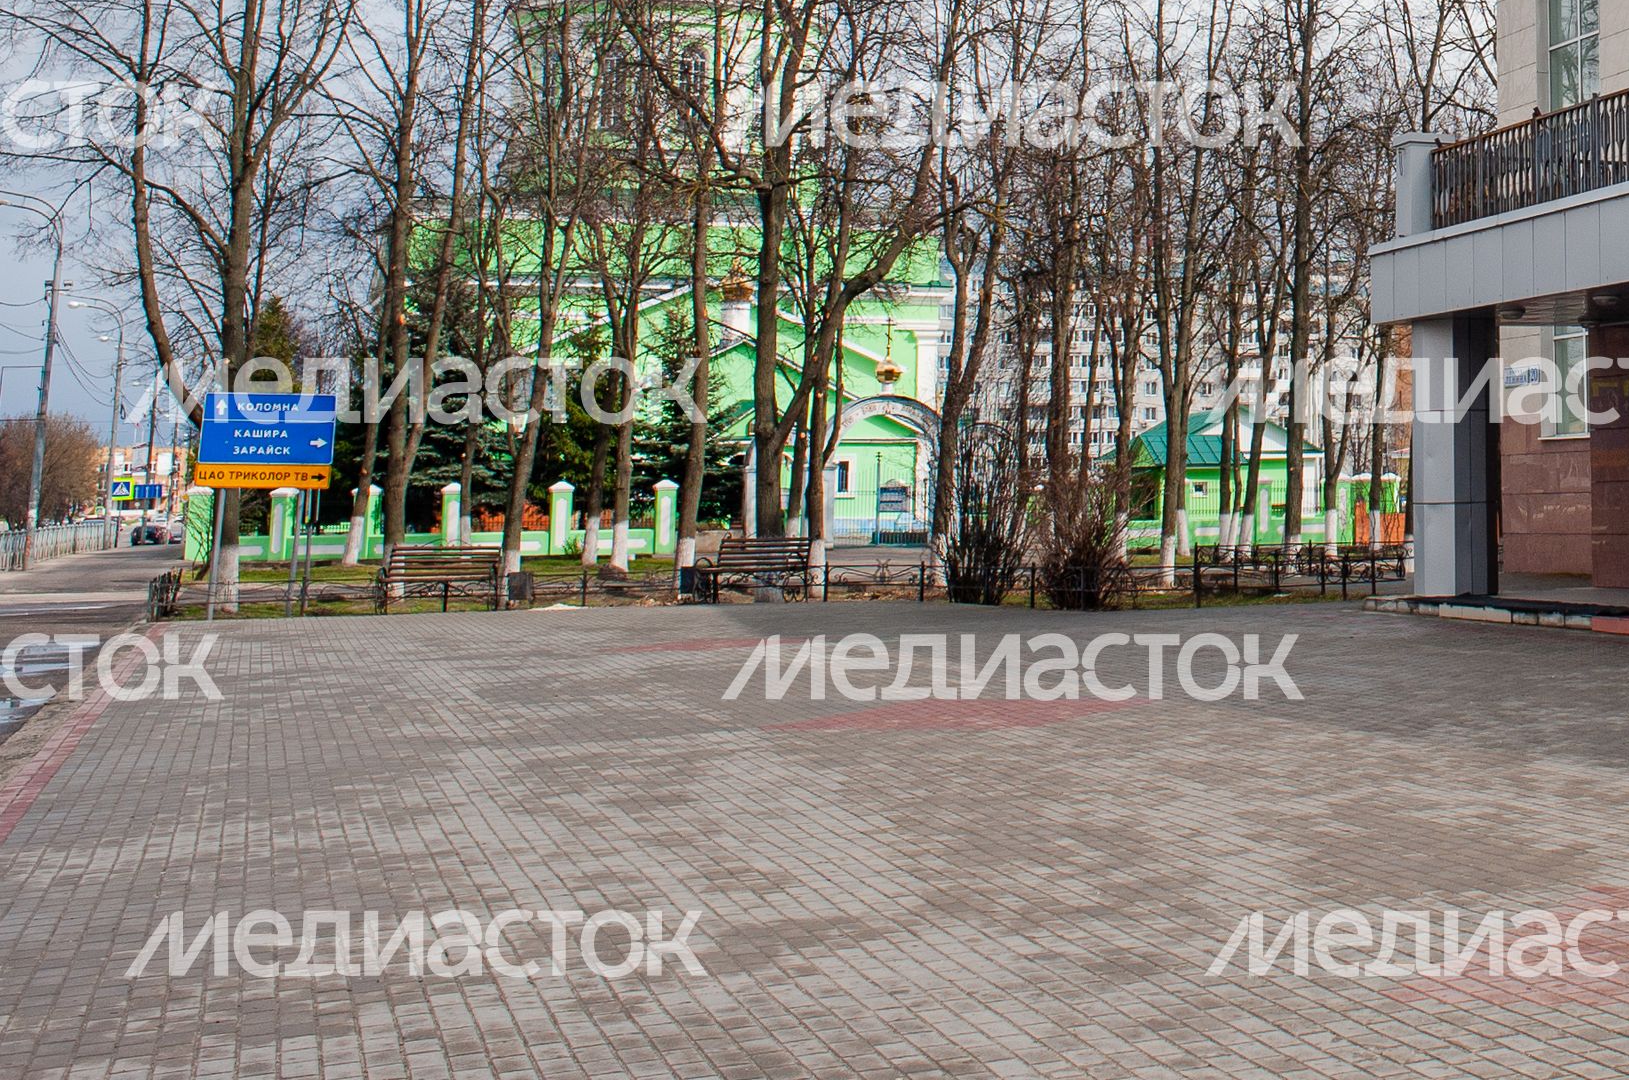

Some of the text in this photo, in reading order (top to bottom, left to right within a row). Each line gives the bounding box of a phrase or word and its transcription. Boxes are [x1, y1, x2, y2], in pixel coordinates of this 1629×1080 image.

[237, 402, 300, 412] КОЛОМНА
[234, 429, 288, 438] КАШИРА
[233, 445, 290, 455] ЗАРАЙСК
[198, 471, 308, 482] ЦАО ТРИКОЛОР ТВ
